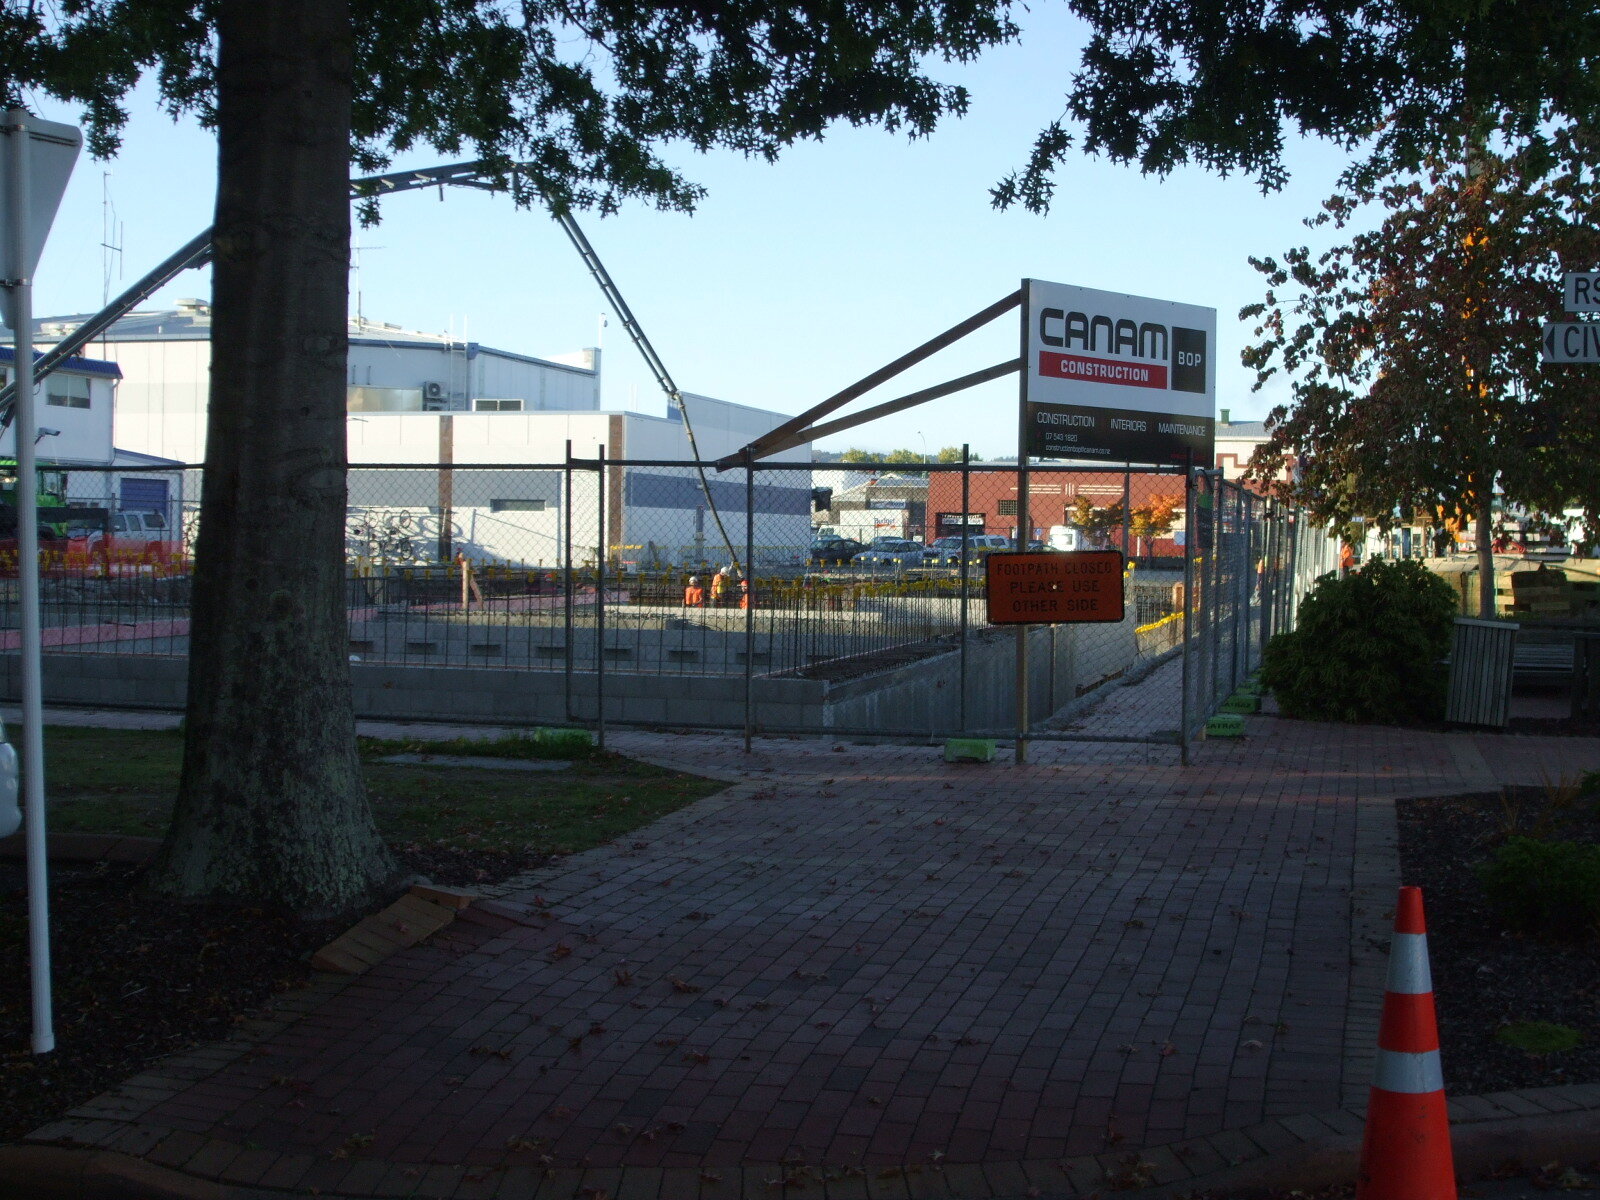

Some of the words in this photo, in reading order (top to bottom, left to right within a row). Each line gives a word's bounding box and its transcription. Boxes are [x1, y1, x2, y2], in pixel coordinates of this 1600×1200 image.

[1040, 308, 1168, 360] CANAM
[1178, 351, 1202, 367] BOP
[1060, 360, 1149, 382] CONSTRUCTION
[1037, 411, 1095, 427] CONSTRUCTION
[1110, 418, 1147, 432] INTERIORS
[1158, 422, 1206, 437] MAINTENANCE
[1045, 432, 1053, 440] 07
[996, 563, 1058, 576] FOOTPATH
[1064, 561, 1112, 575] CLOSED
[1010, 580, 1064, 594] PLEASE
[1072, 580, 1101, 592] USE
[1012, 600, 1058, 613] OTHER
[1067, 599, 1099, 611] SIDE
